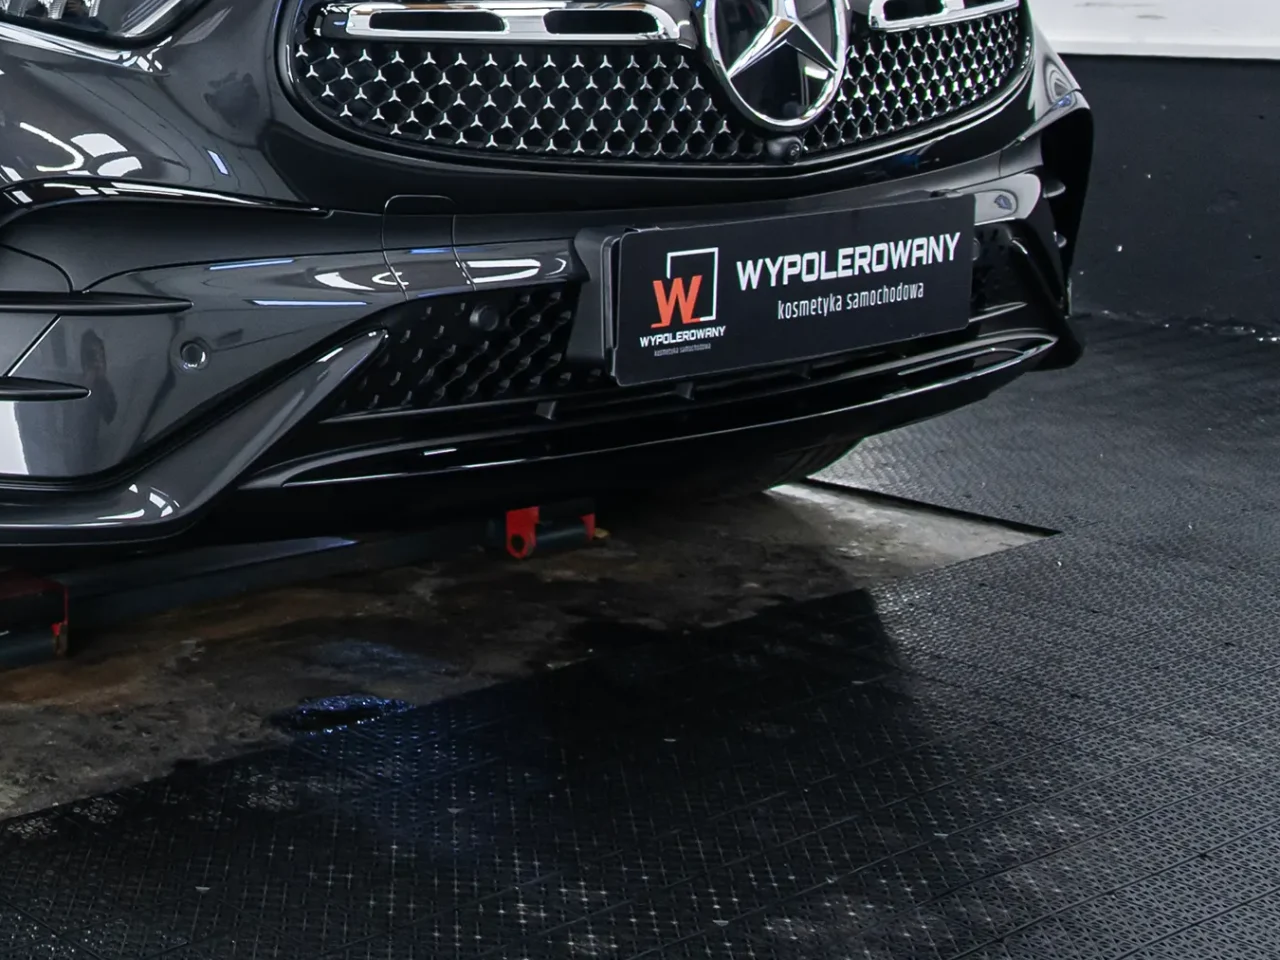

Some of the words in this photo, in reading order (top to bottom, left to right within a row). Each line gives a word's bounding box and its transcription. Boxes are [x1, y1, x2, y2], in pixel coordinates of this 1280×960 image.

[736, 232, 961, 291] WYPOLEROWANY
[777, 293, 843, 320] kosmetyka
[846, 282, 924, 310] samochodowa
[639, 326, 726, 347] WYPOLEROWANY
